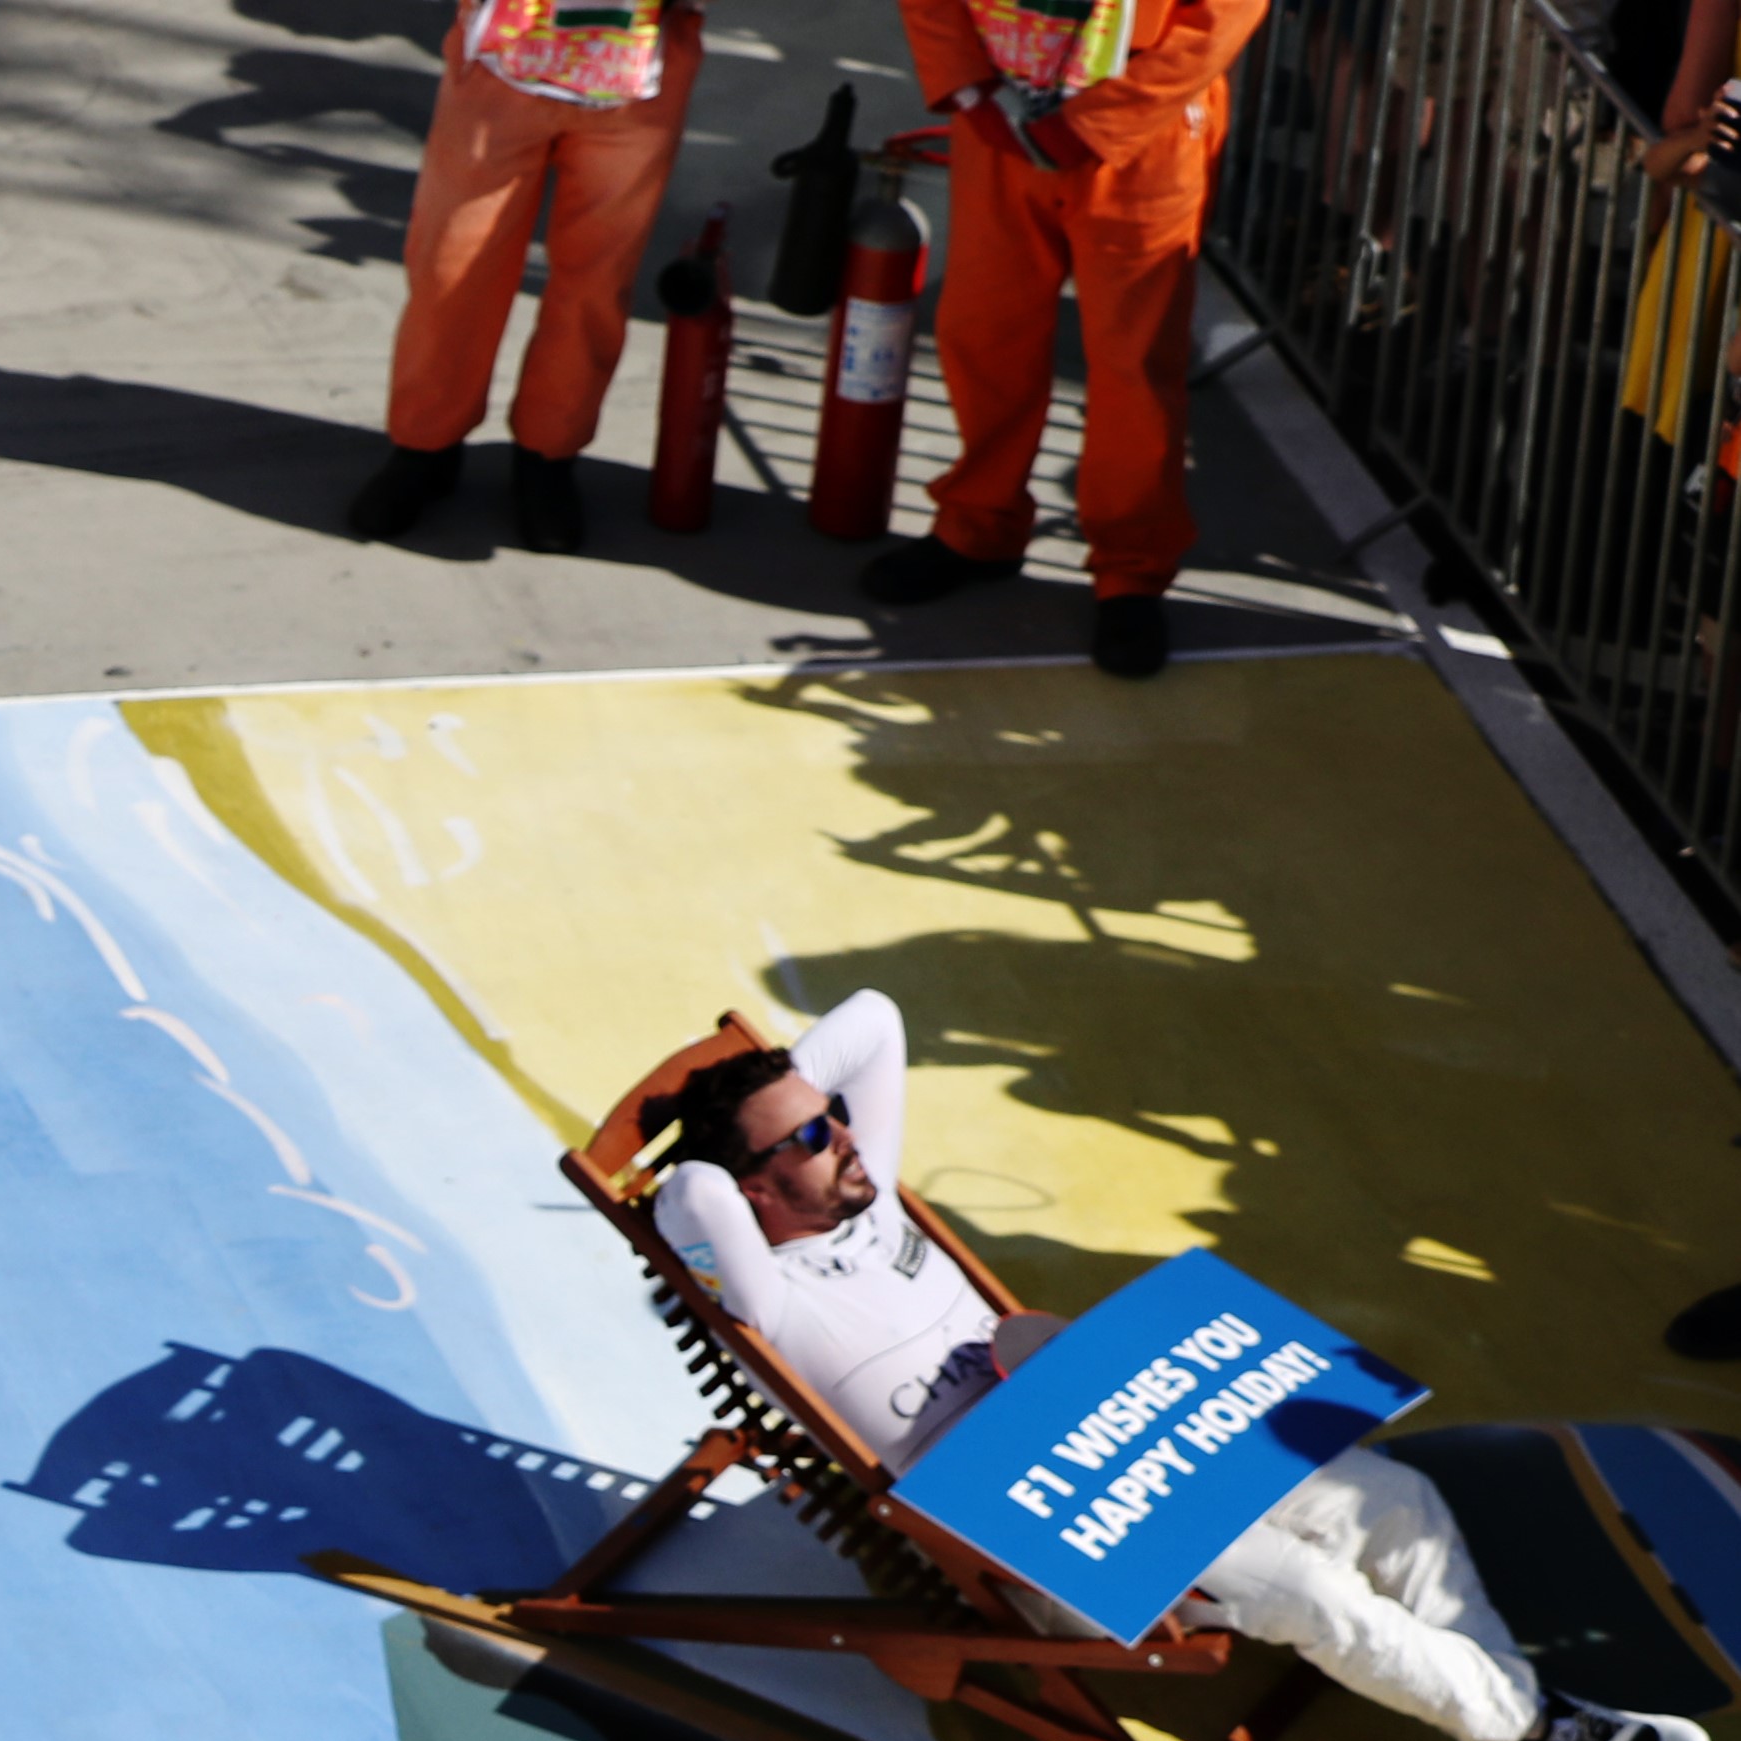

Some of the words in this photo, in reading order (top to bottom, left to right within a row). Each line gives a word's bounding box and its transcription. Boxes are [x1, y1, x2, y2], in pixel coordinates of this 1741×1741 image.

[1006, 1464, 1077, 1520] F1
[1050, 1356, 1199, 1471] WISHES
[1169, 1311, 1262, 1372] YOU
[1059, 1435, 1197, 1562] HAPPY
[1172, 1340, 1333, 1456] HOLIDAY!
